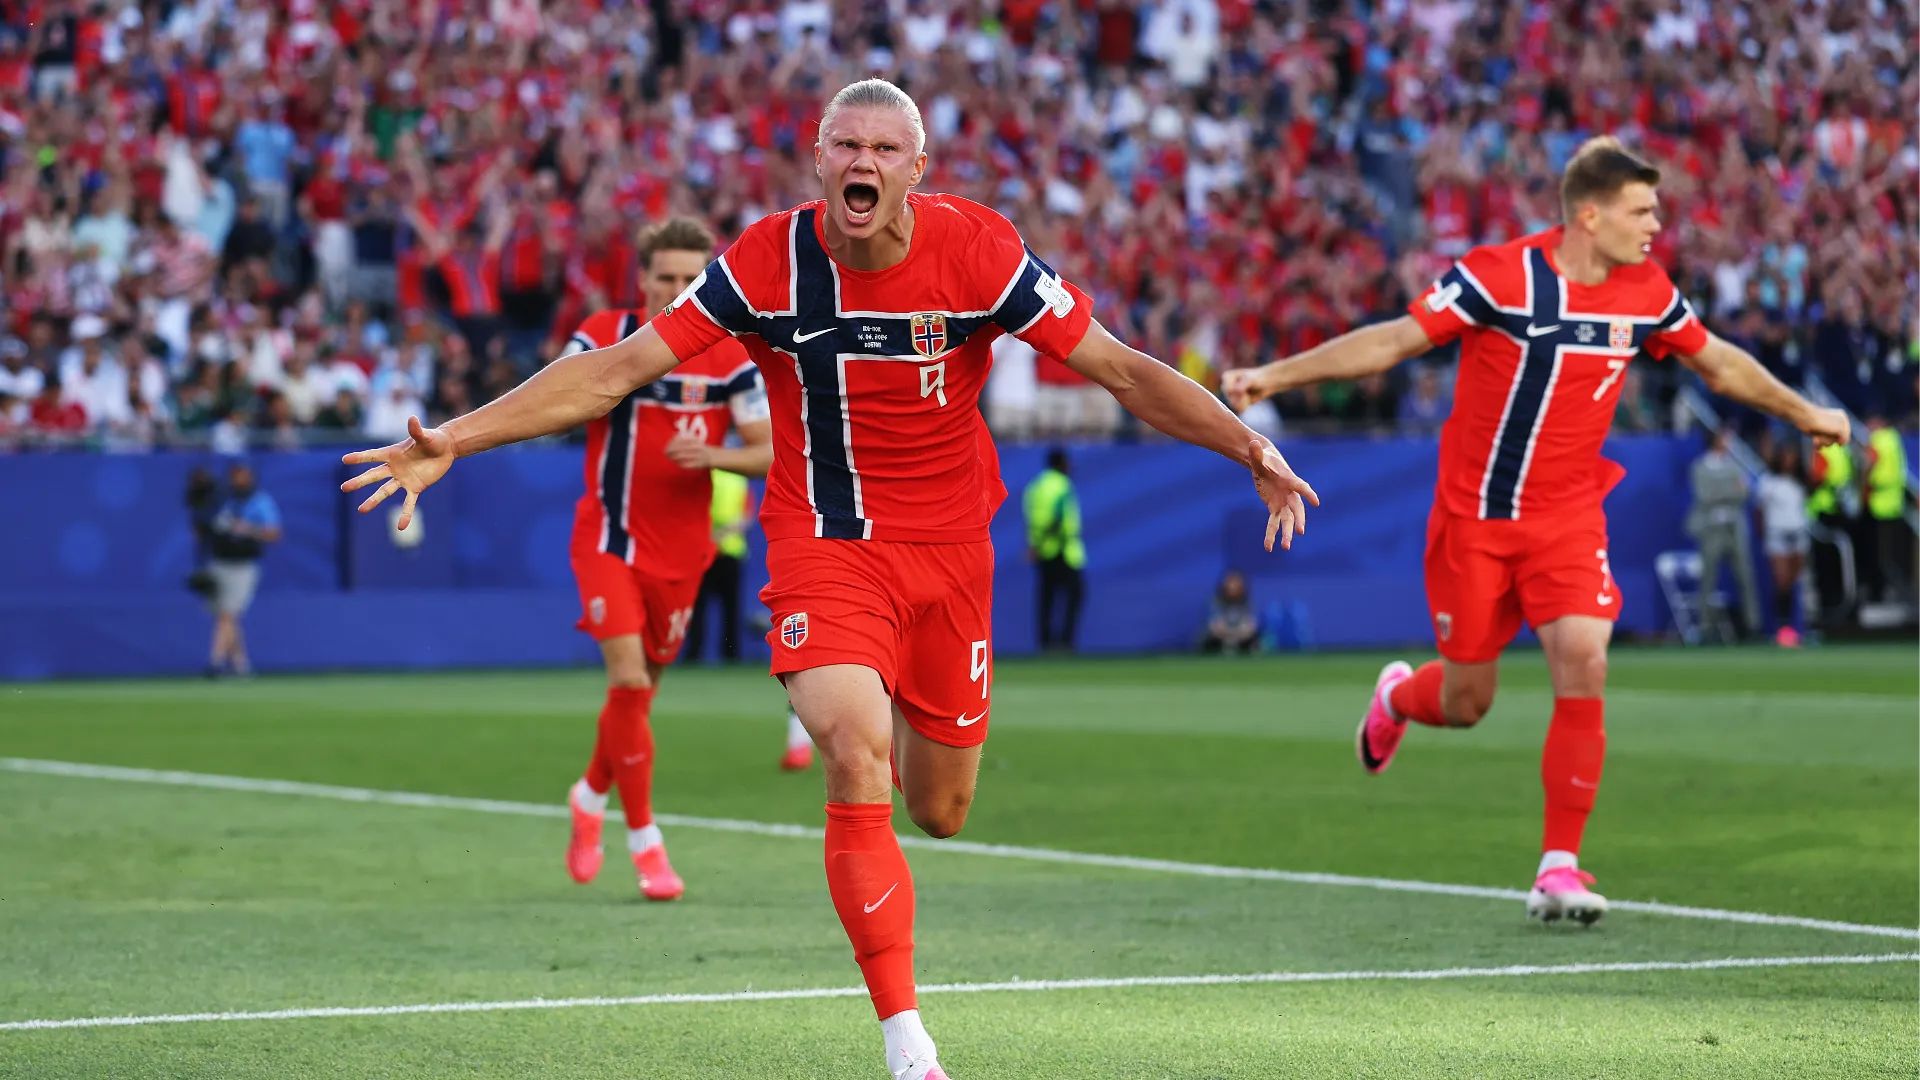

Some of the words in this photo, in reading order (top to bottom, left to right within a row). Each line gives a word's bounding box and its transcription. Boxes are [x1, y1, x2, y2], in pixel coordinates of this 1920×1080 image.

[919, 360, 947, 408] 9
[1592, 359, 1626, 402] 7
[969, 639, 988, 700] 9
